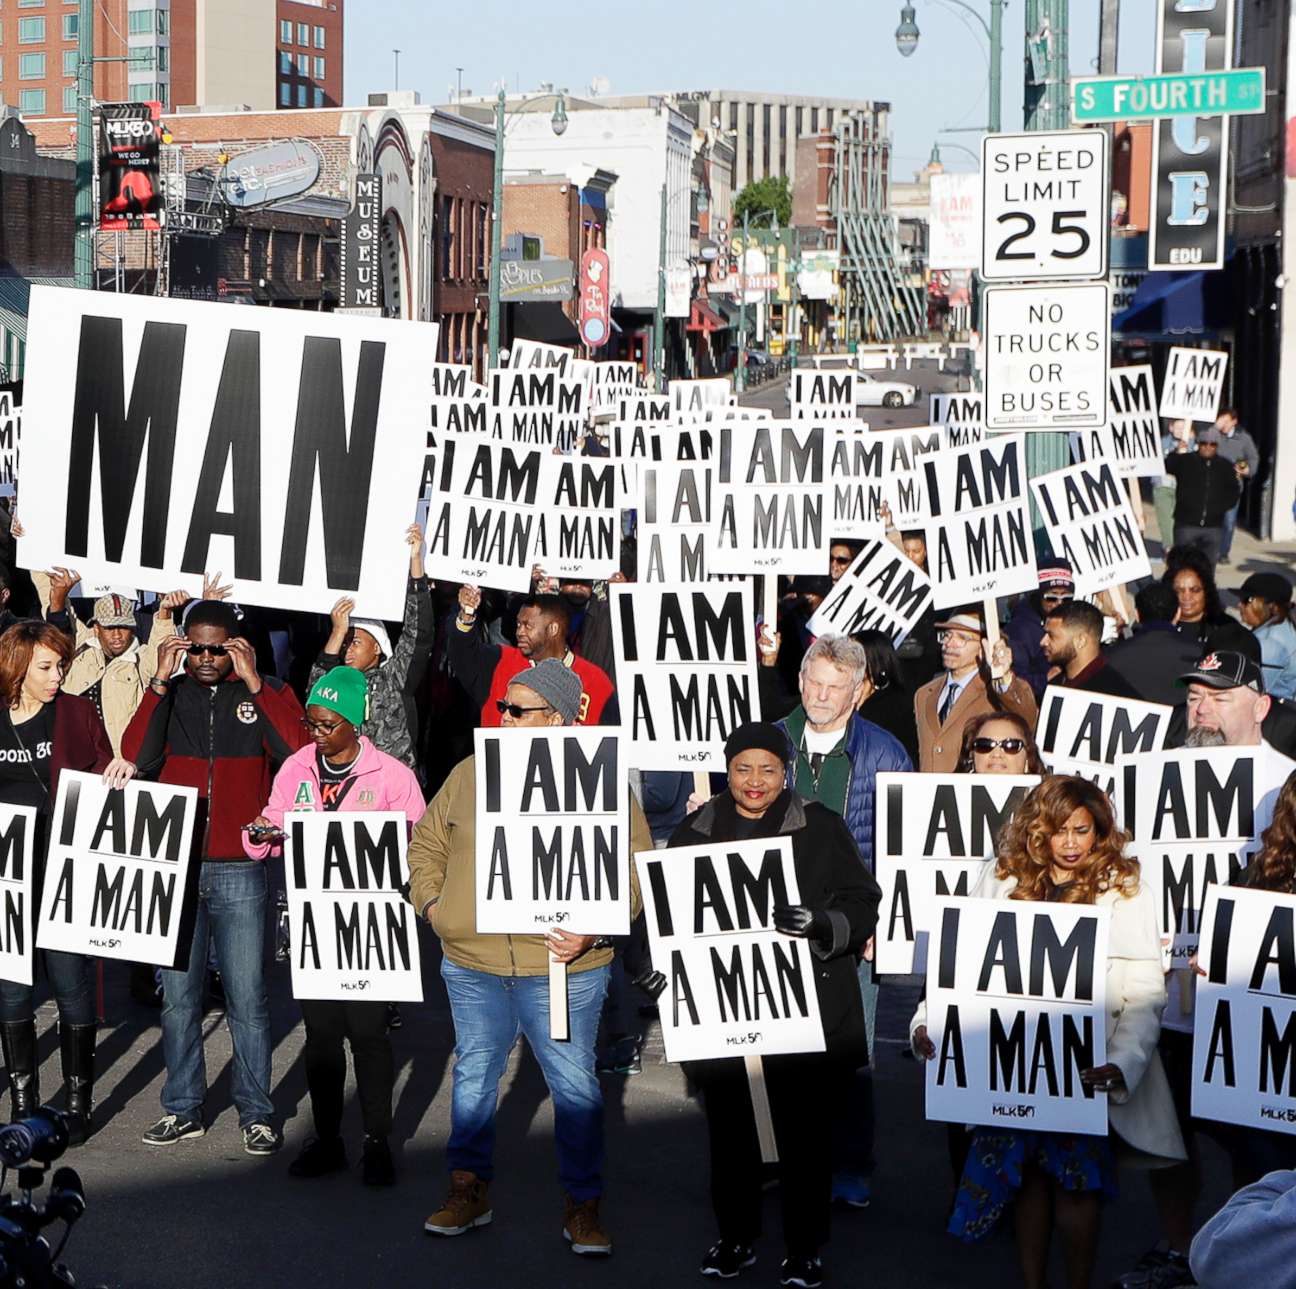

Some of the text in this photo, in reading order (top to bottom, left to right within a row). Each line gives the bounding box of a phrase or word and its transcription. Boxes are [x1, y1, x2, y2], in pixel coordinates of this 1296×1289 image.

[1081, 88, 1095, 110] S
[1113, 79, 1227, 113] FOURTH
[106, 120, 153, 138] MLK50
[994, 149, 1094, 174] SPEED
[1004, 180, 1082, 202] LIMIT
[356, 181, 374, 306] MUSEUM
[995, 210, 1091, 260] 25
[1169, 247, 1202, 264] EDU
[994, 331, 1100, 354] TRUCKS
[1028, 304, 1063, 324] NO
[493, 373, 554, 406] I AM
[596, 366, 633, 384] I AM
[796, 375, 851, 403] I AM
[1029, 363, 1063, 384] OR
[1172, 354, 1221, 381] I AM
[493, 412, 552, 444] A MAN
[934, 399, 939, 422] I
[946, 399, 981, 423] AM
[1001, 391, 1091, 413] BUSES
[65, 315, 386, 593] MAN
[719, 428, 824, 483] I AM
[1092, 420, 1157, 459] A MAN
[440, 440, 455, 492] I
[464, 444, 541, 504] AM
[554, 463, 614, 508] AM
[924, 442, 1020, 517] I AM
[1038, 464, 1121, 526] I AM
[426, 502, 532, 568] A MAN
[535, 513, 613, 560] A MAN
[719, 494, 822, 549] A MAN
[939, 508, 1028, 583] A MAN
[1061, 509, 1139, 575] A MAN
[853, 541, 931, 620] I AM
[619, 592, 746, 661] I AM
[316, 687, 339, 703] AKA
[633, 674, 750, 741] A MAN
[485, 737, 618, 812] I AM
[1124, 758, 1255, 842] I AM
[60, 781, 187, 861] I AM
[292, 821, 401, 889] I AM
[487, 825, 618, 901] A MAN
[49, 858, 176, 937] A MAN
[647, 849, 788, 937] I AM
[888, 870, 914, 941] A
[300, 902, 410, 970] A MAN
[938, 908, 1098, 1001] I AM
[1209, 898, 1235, 985] I
[672, 940, 808, 1027] A MAN
[937, 1005, 1095, 1097] A MAN
[1204, 999, 1235, 1087] A
